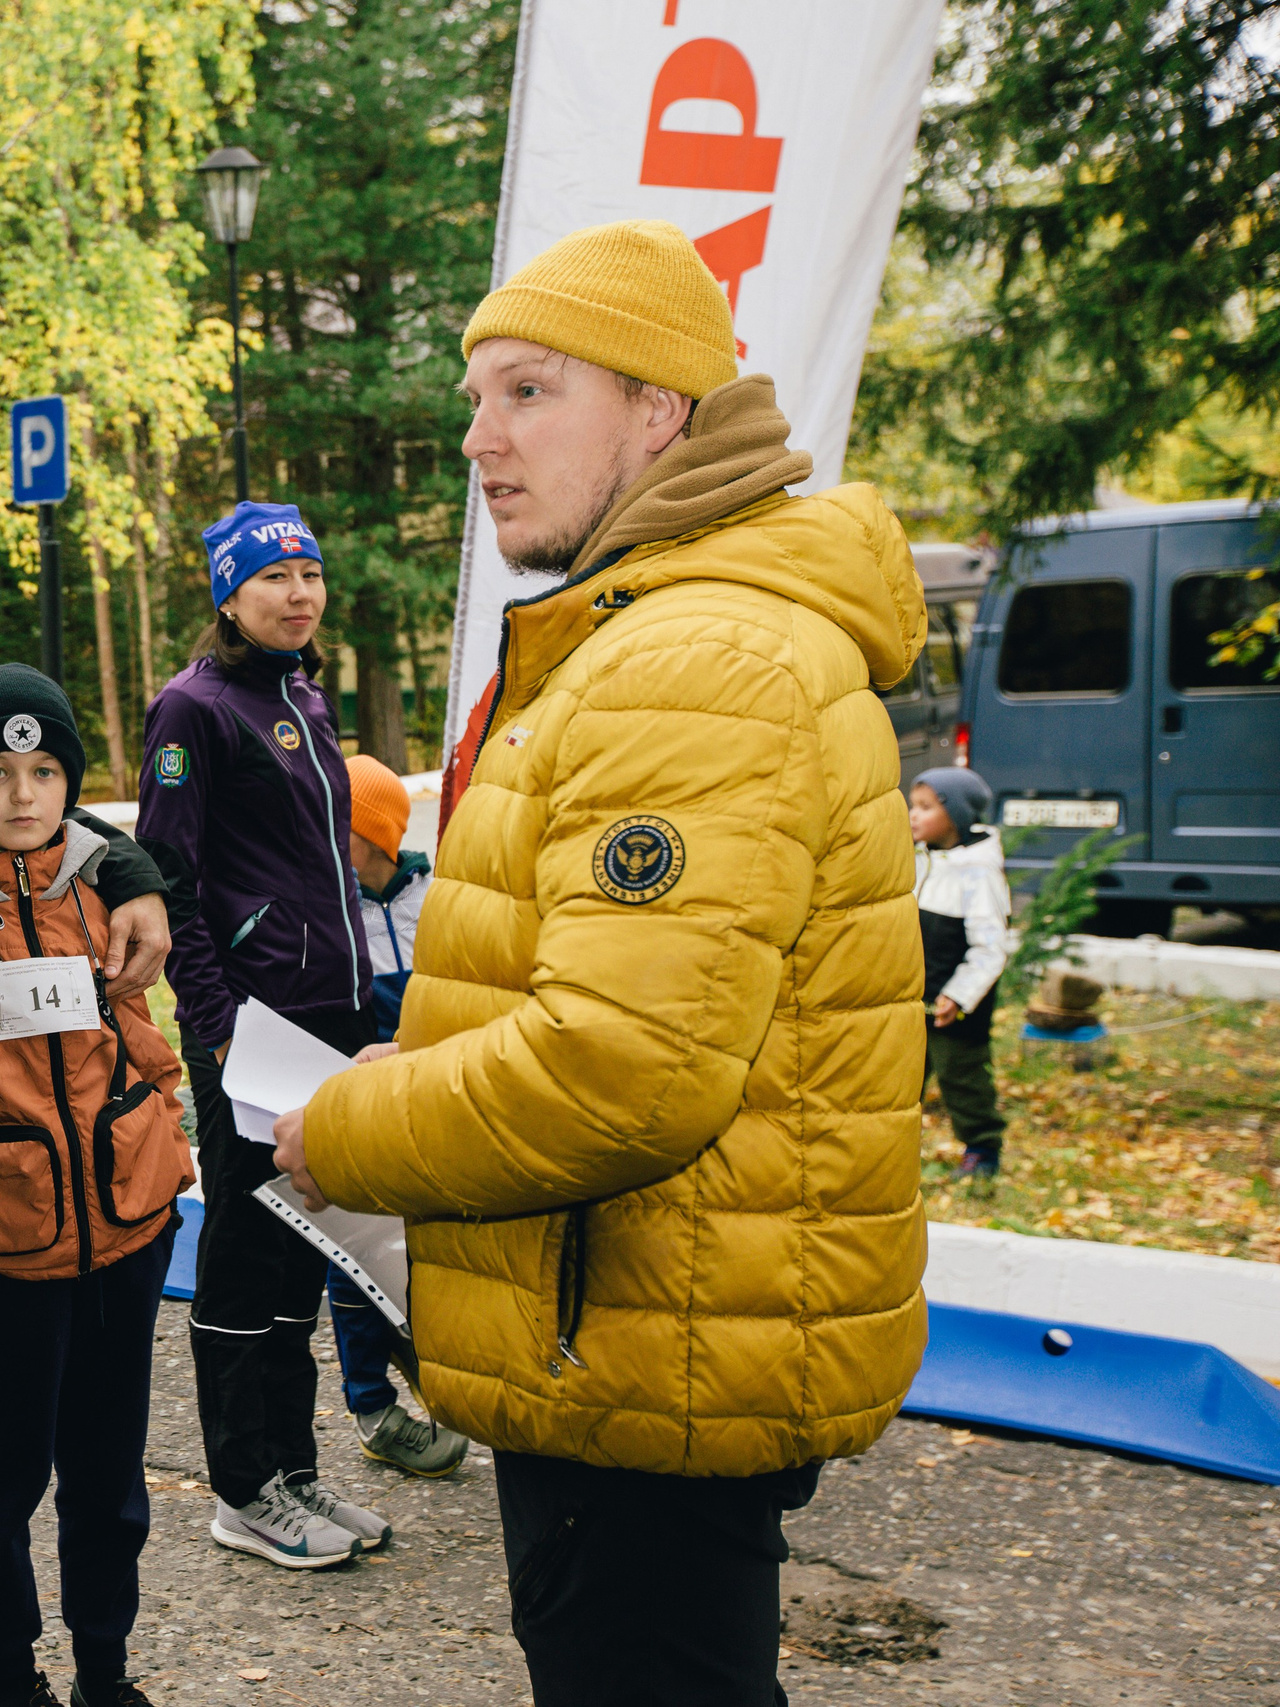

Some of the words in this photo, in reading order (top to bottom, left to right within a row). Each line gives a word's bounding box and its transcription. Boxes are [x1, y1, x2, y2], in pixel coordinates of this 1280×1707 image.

[20, 414, 55, 489] P
[251, 522, 313, 543] VITAL
[9, 719, 36, 731] CONVERSE
[11, 740, 21, 748] ALL
[22, 740, 34, 748] STAR
[596, 855, 646, 900] ELEMENTS
[652, 856, 684, 896] THREE
[28, 984, 61, 1012] 14
